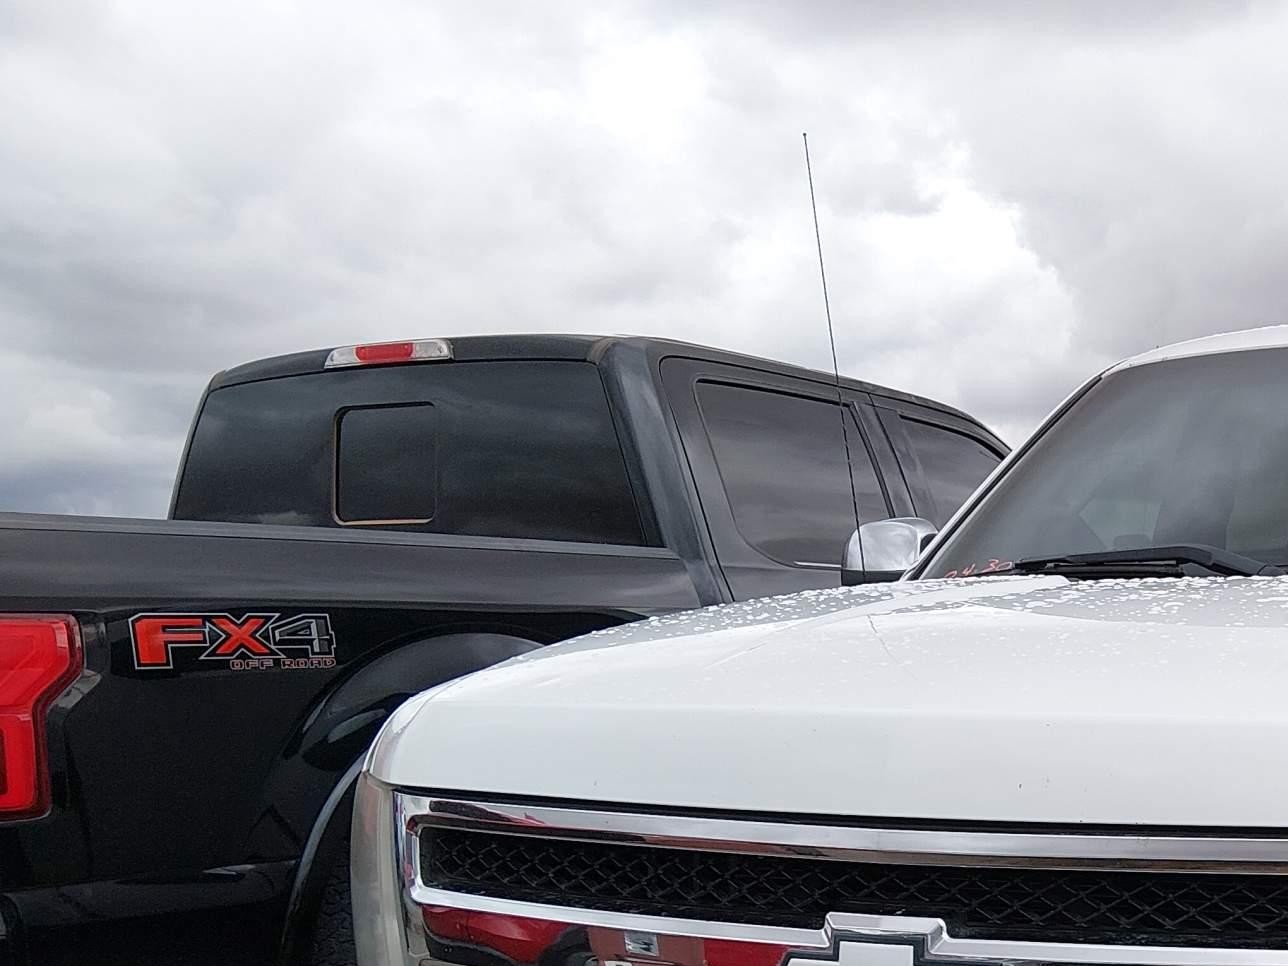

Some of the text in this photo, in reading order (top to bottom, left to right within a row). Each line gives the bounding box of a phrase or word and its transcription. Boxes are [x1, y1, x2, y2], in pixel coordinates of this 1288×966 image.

[128, 612, 337, 670] FX4
[229, 657, 337, 670] OFF ROAD
